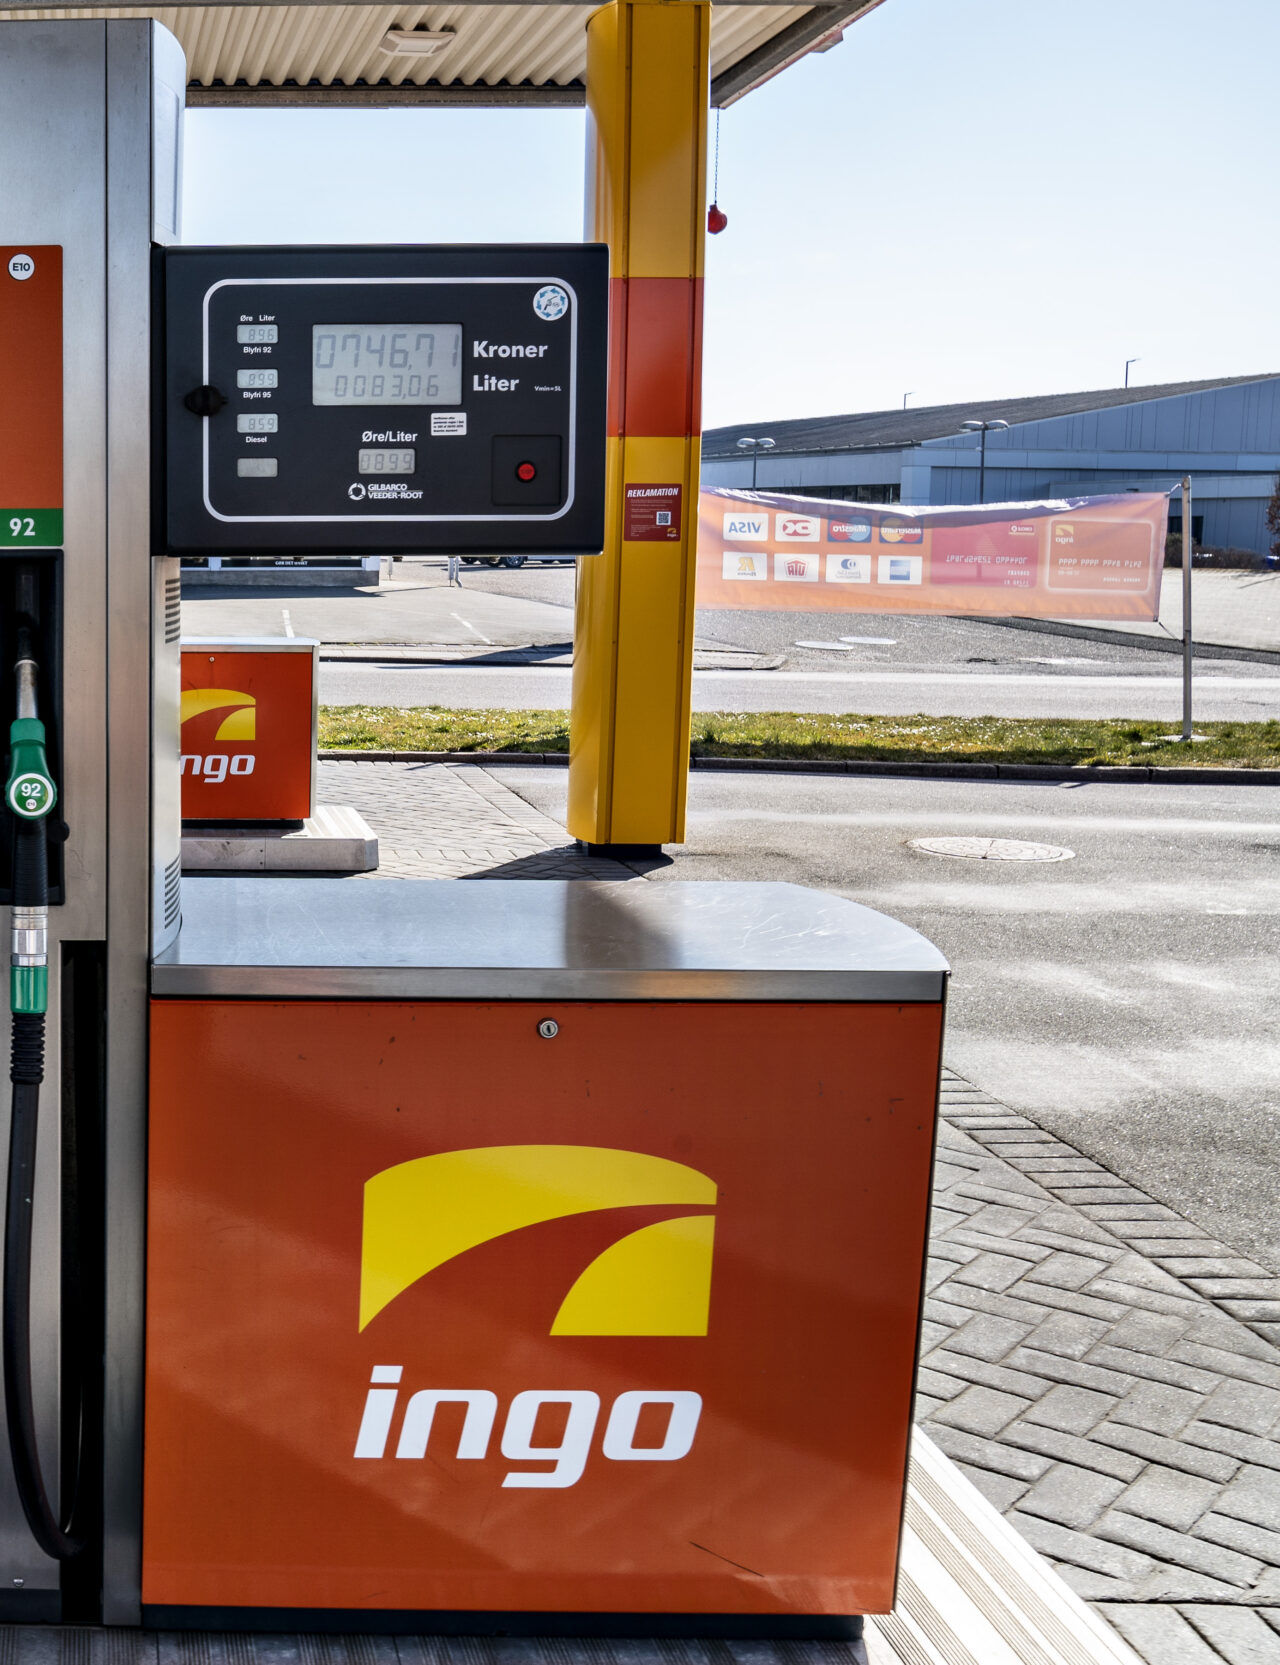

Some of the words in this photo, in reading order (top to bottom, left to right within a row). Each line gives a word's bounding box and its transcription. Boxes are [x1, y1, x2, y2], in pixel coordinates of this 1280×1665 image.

[12, 262, 31, 272] E10
[243, 346, 261, 355] Blyfri
[262, 346, 272, 354] 92
[473, 340, 548, 358] Kroner
[472, 374, 520, 392] Liter
[243, 391, 261, 400] Blyfri
[262, 391, 272, 399] 95
[361, 430, 419, 442] Øre/Liter
[367, 483, 408, 491] GILBARCO
[367, 491, 424, 499] VEEDER-ROOT
[627, 488, 679, 498] REKLAMATION
[9, 518, 36, 537] 92
[21, 783, 41, 797] 92
[353, 1365, 703, 1489] ingo
